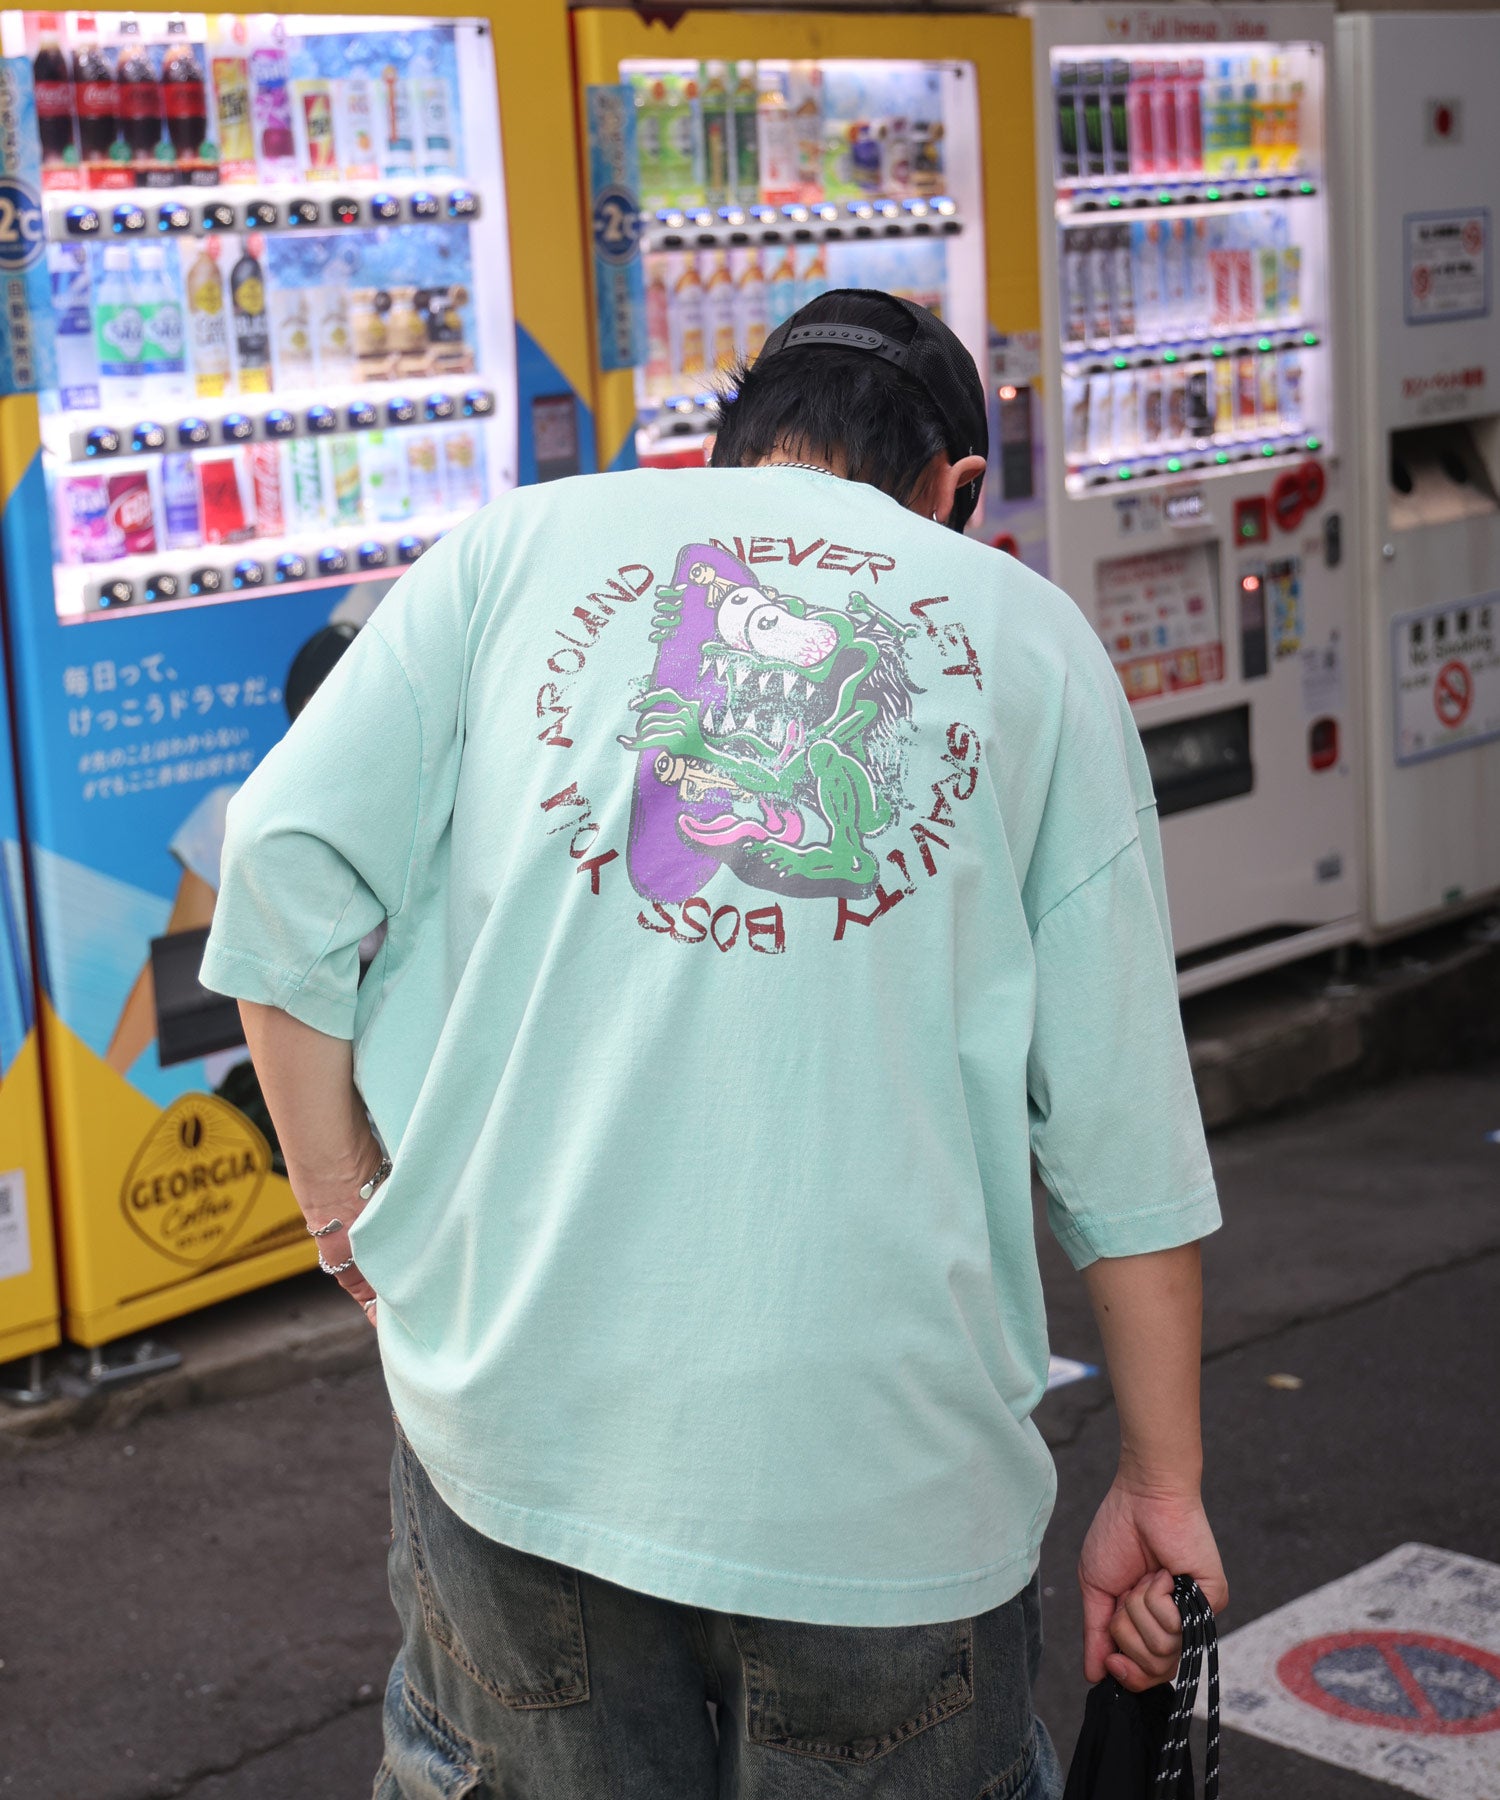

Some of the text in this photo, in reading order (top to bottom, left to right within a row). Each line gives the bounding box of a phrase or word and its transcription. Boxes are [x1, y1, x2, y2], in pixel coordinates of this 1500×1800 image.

[708, 536, 896, 584] NEVER
[536, 564, 654, 748] AROUND
[909, 596, 983, 692] LET
[62, 652, 178, 698] 毎日って、
[68, 675, 283, 737] けっこうドラマだ。
[833, 722, 981, 941] GRAVITY
[637, 897, 786, 955] BOSS
[131, 1151, 256, 1211] GEORGIA
